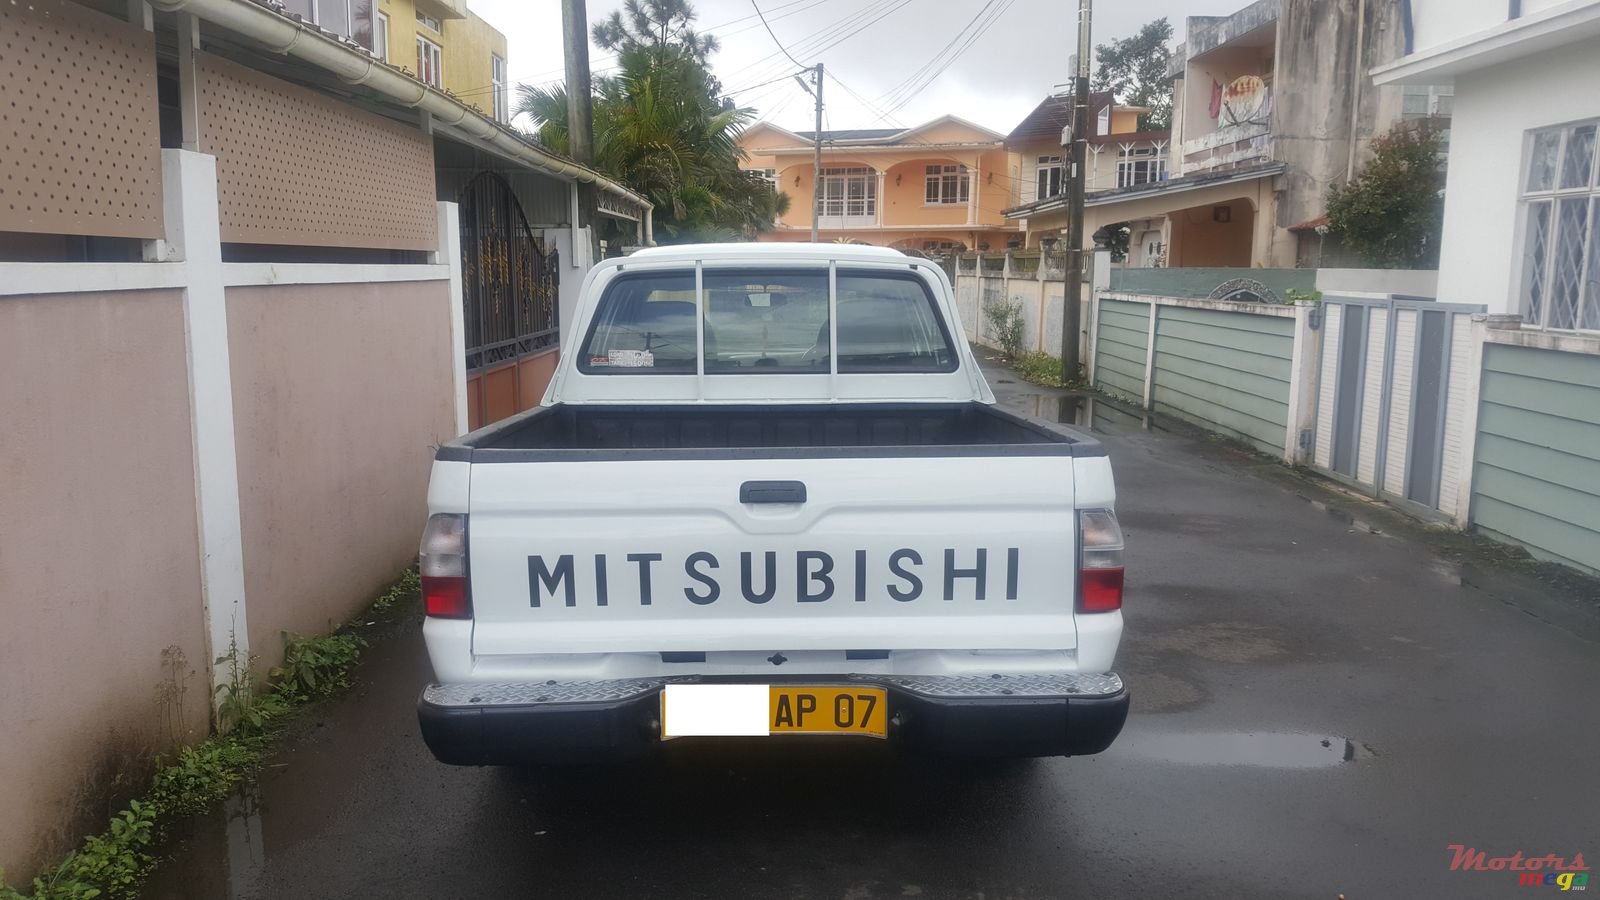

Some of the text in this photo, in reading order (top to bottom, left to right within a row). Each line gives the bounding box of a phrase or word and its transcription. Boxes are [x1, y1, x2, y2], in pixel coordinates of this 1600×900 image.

[527, 546, 1020, 608] MITSUBISHI
[774, 693, 878, 729] AP 07
